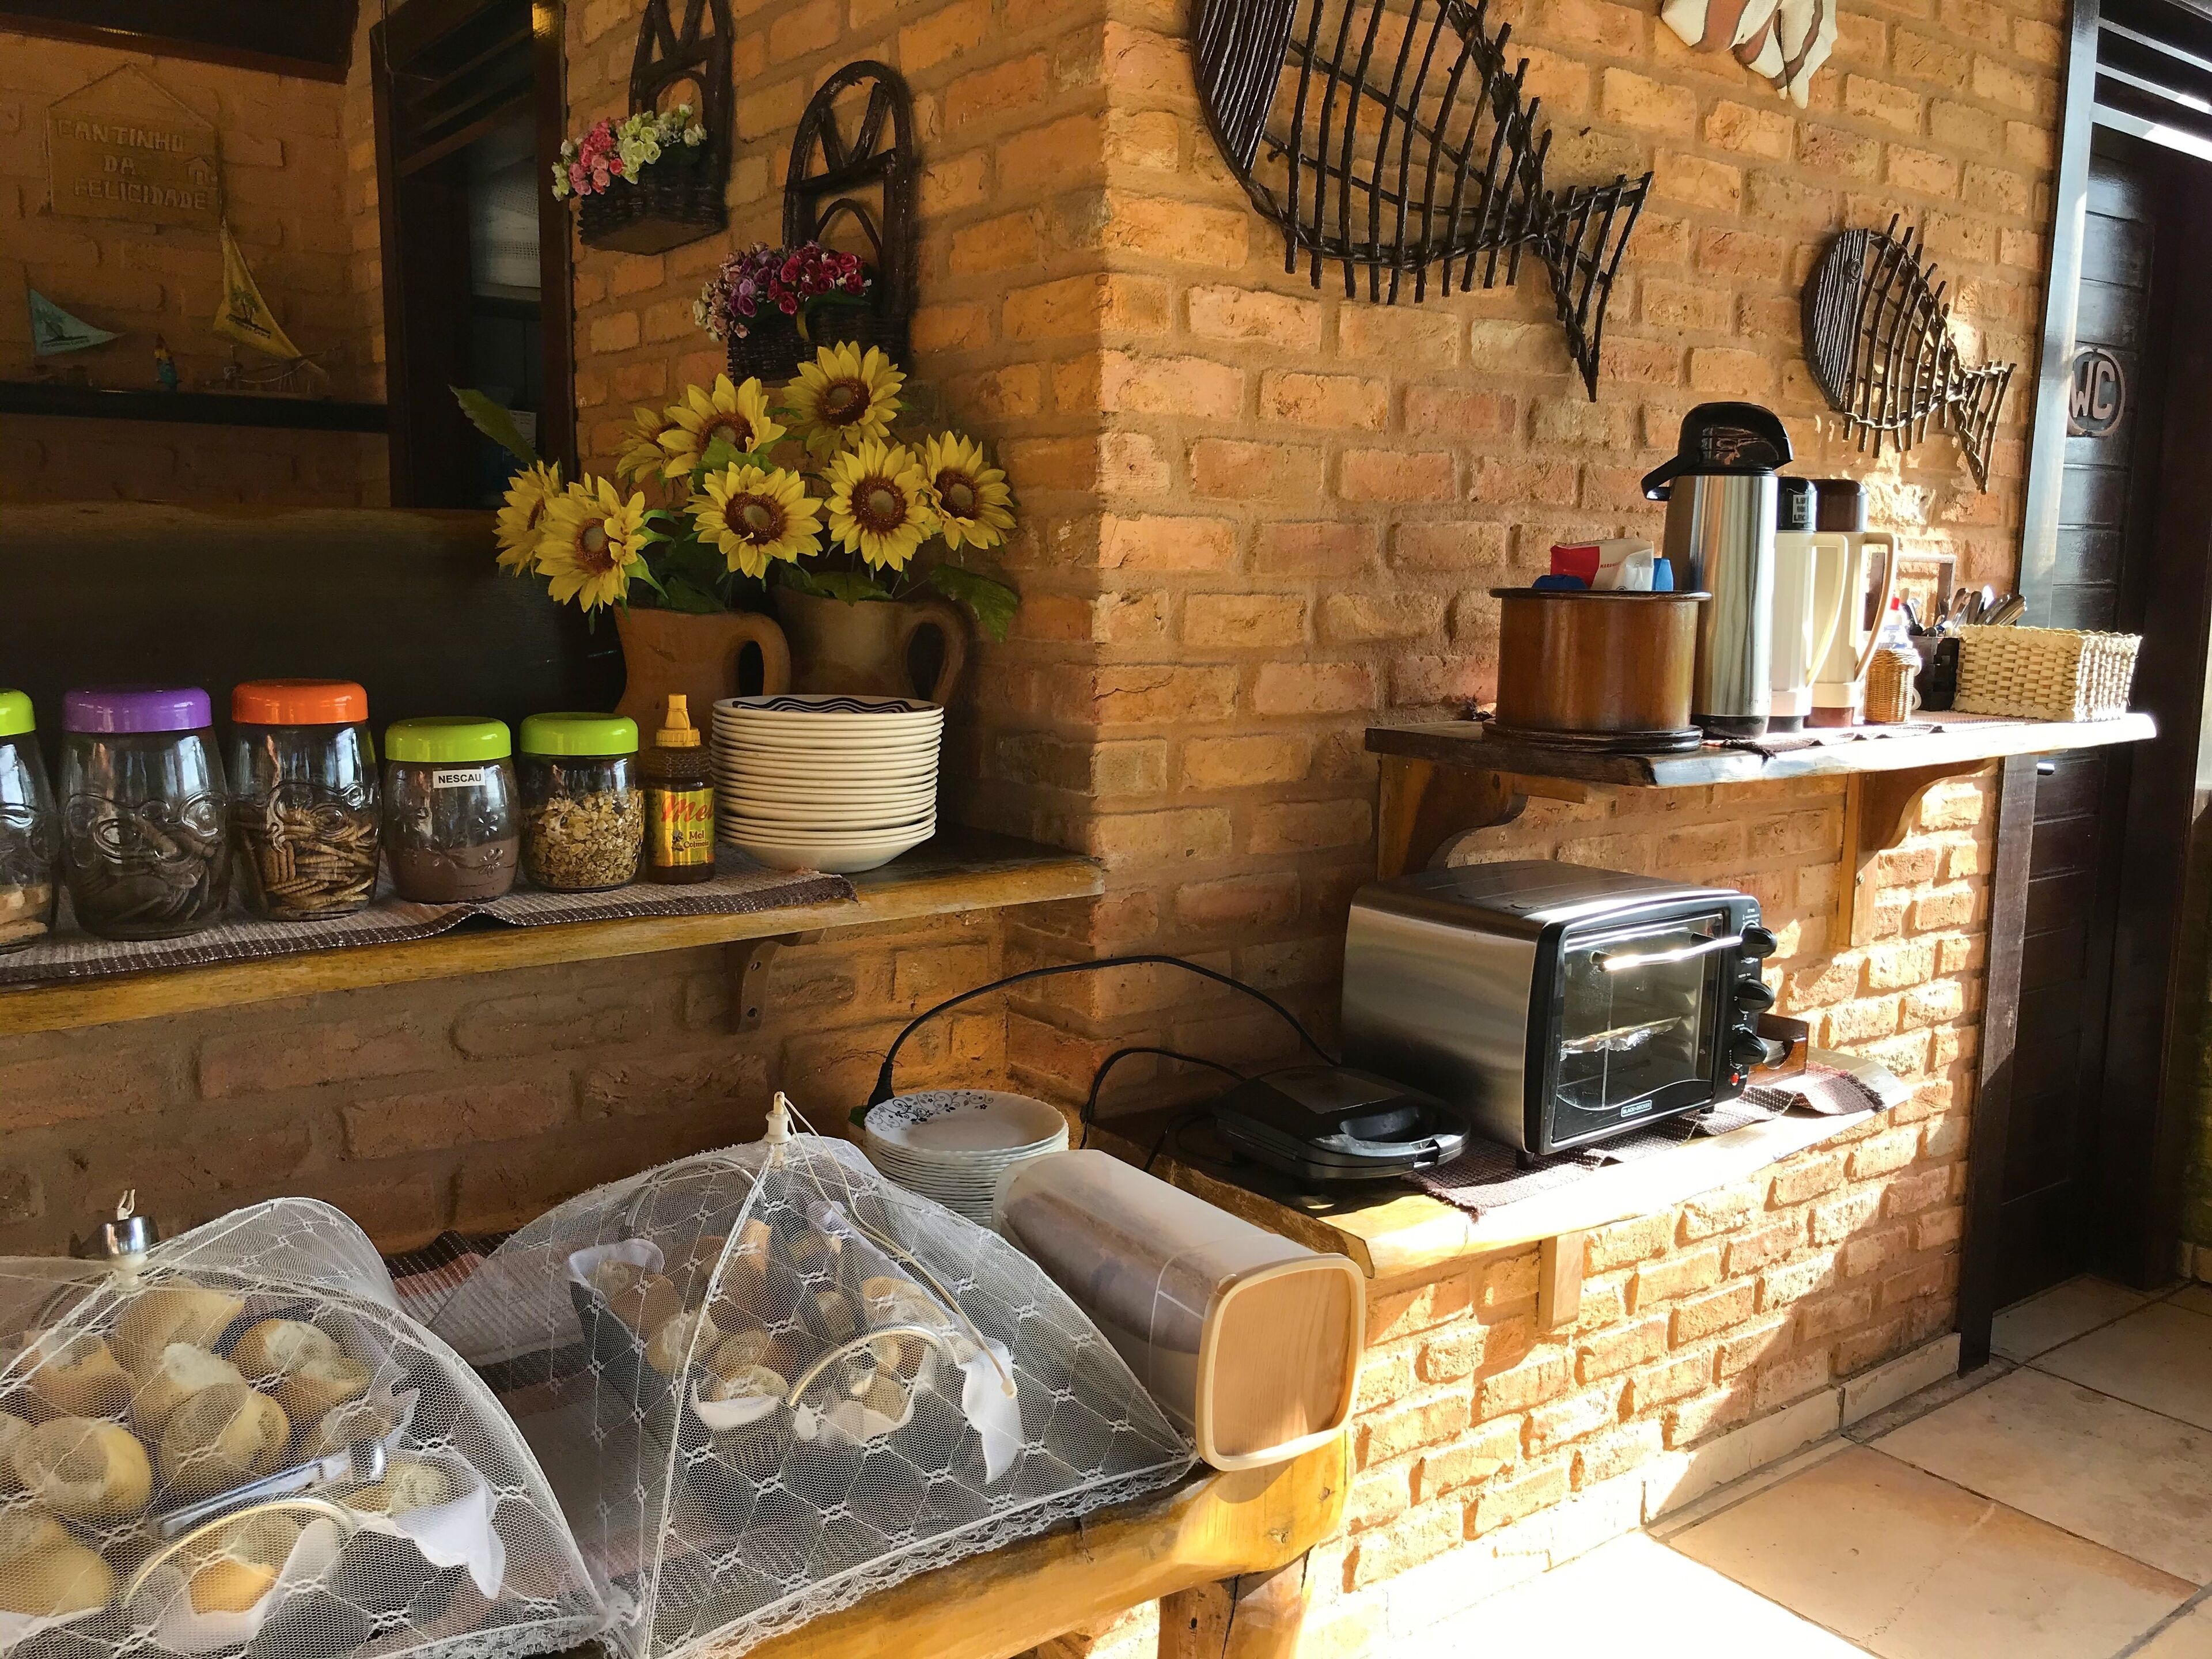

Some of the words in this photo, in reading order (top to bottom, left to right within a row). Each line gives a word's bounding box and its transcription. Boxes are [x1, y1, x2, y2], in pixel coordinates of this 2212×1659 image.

[56, 119, 184, 152] CANTINHO
[104, 154, 136, 176] DA
[73, 177, 208, 210] FELICIDADE
[2070, 360, 2115, 419] WC
[438, 774, 482, 783] NESCAU
[661, 794, 713, 823] Mel
[689, 830, 704, 840] Mel
